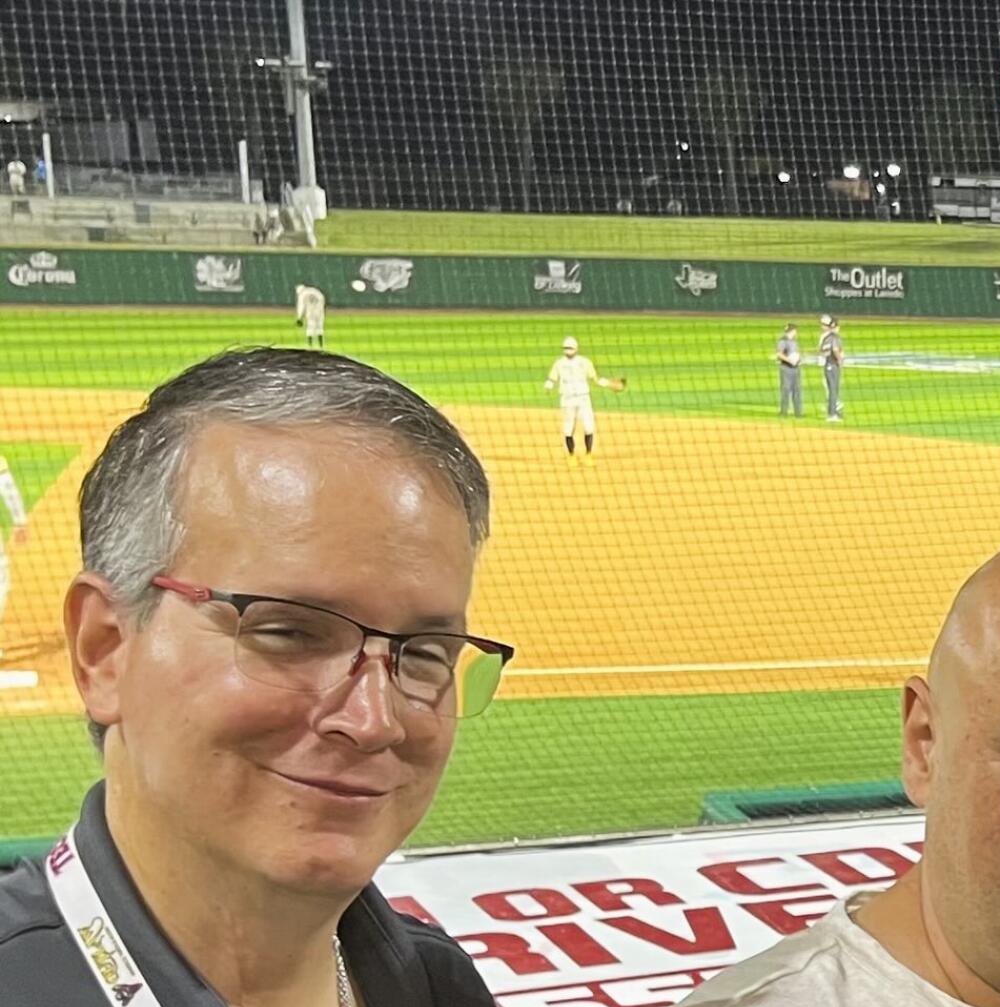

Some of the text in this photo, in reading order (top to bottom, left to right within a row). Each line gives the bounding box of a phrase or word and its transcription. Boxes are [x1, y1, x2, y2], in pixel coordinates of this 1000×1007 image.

[8, 263, 76, 287] Corona
[830, 267, 904, 290] The Outlet
[697, 841, 924, 895] CD
[453, 894, 838, 975] RIVE
